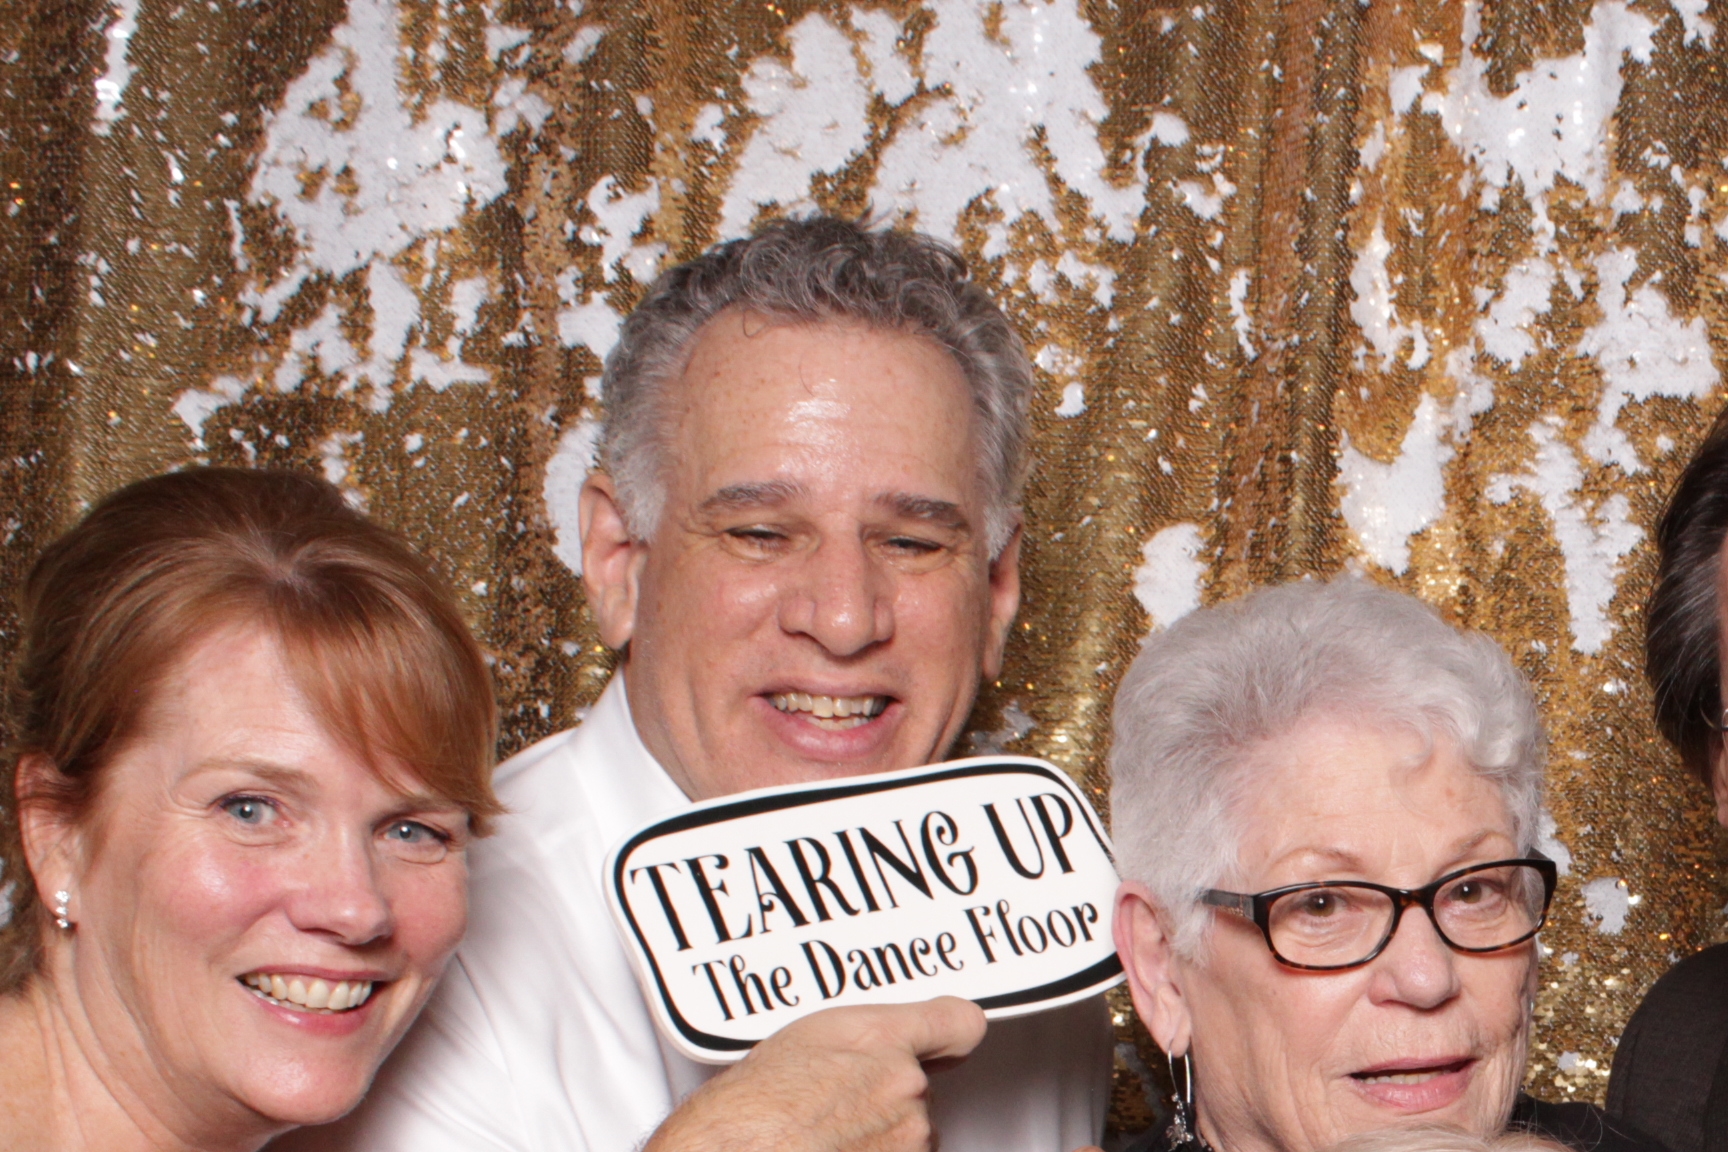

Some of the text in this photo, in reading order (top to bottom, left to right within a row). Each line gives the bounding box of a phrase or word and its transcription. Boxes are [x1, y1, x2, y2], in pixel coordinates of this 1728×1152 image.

[629, 792, 1076, 952] TEARING UP
[691, 898, 1099, 1022] The Dance Floor
